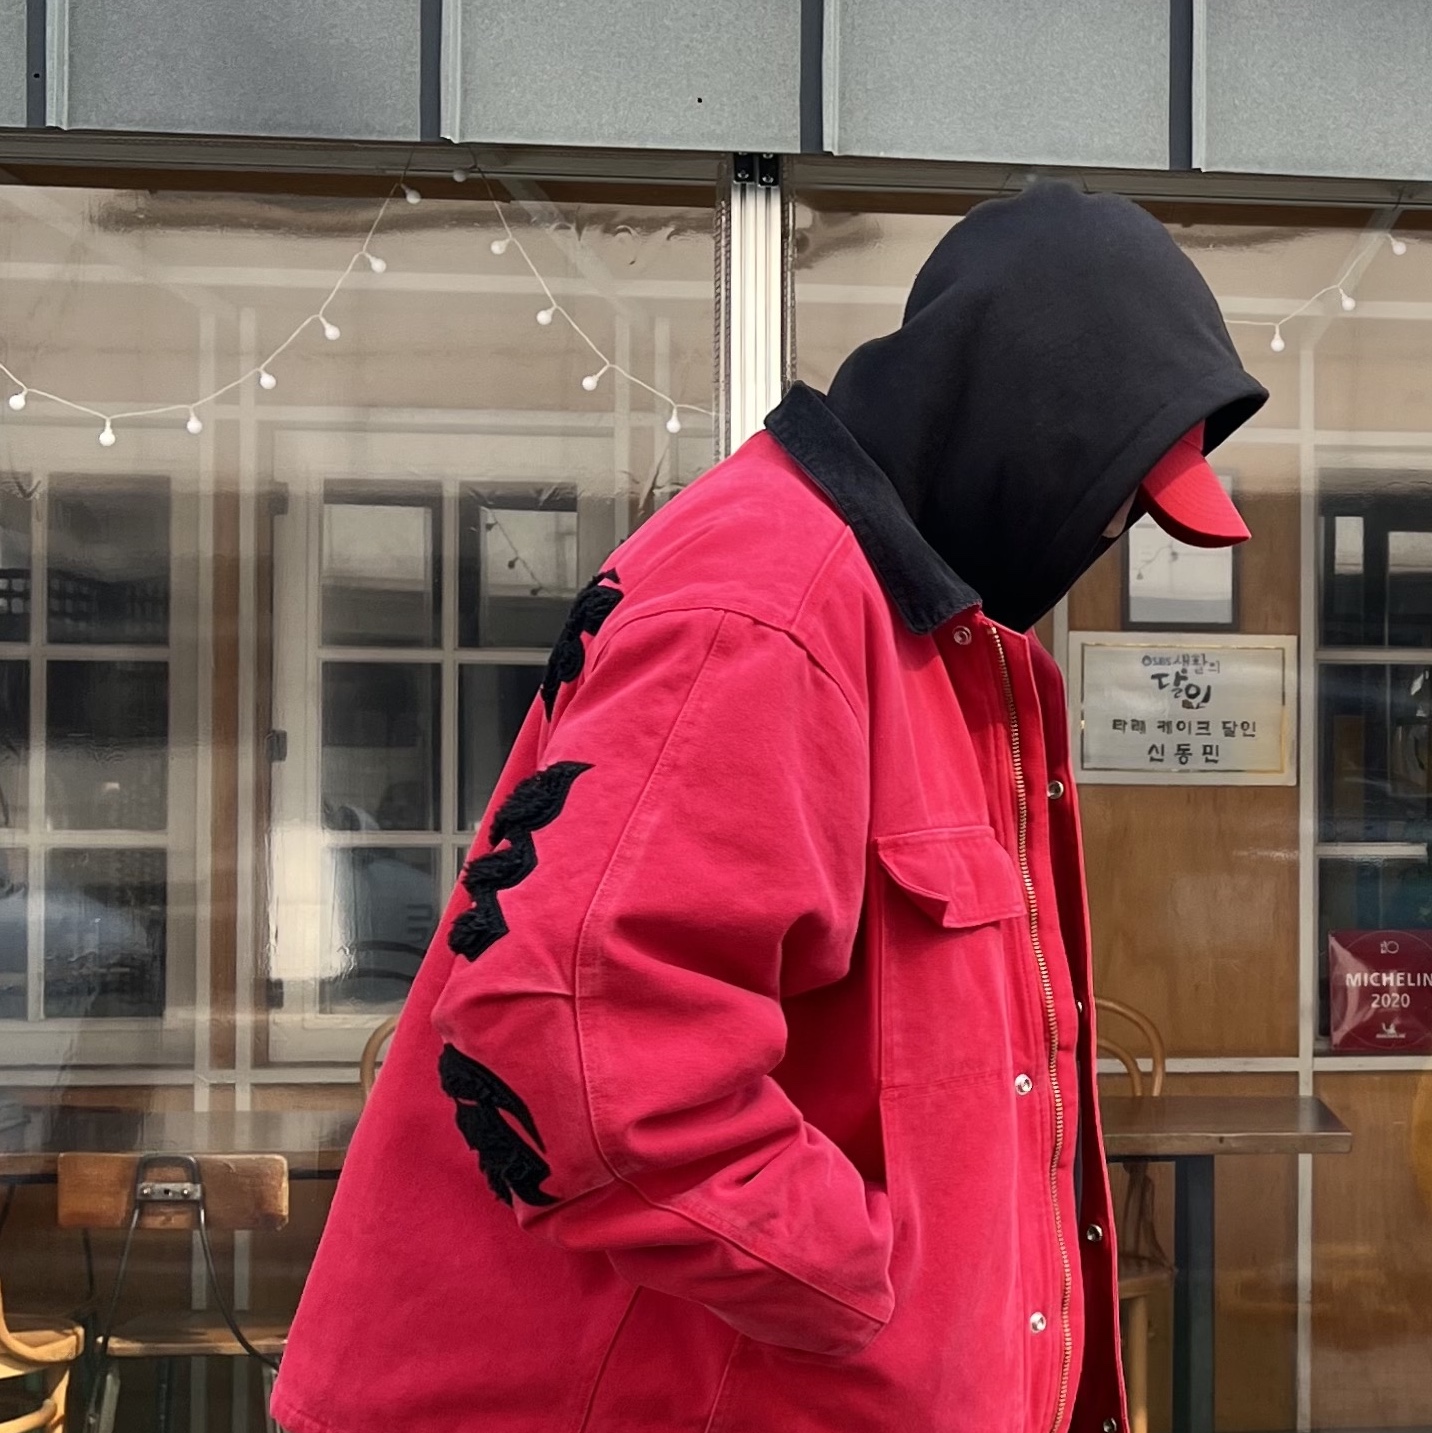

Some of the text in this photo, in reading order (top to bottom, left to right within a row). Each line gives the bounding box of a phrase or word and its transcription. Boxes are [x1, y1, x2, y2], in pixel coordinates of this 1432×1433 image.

[1172, 653, 1220, 674] 생활의
[1151, 669, 1212, 710] 달인
[1156, 720, 1212, 736] 케이크
[1221, 720, 1256, 738] 달인
[1371, 993, 1410, 1008] 2020
